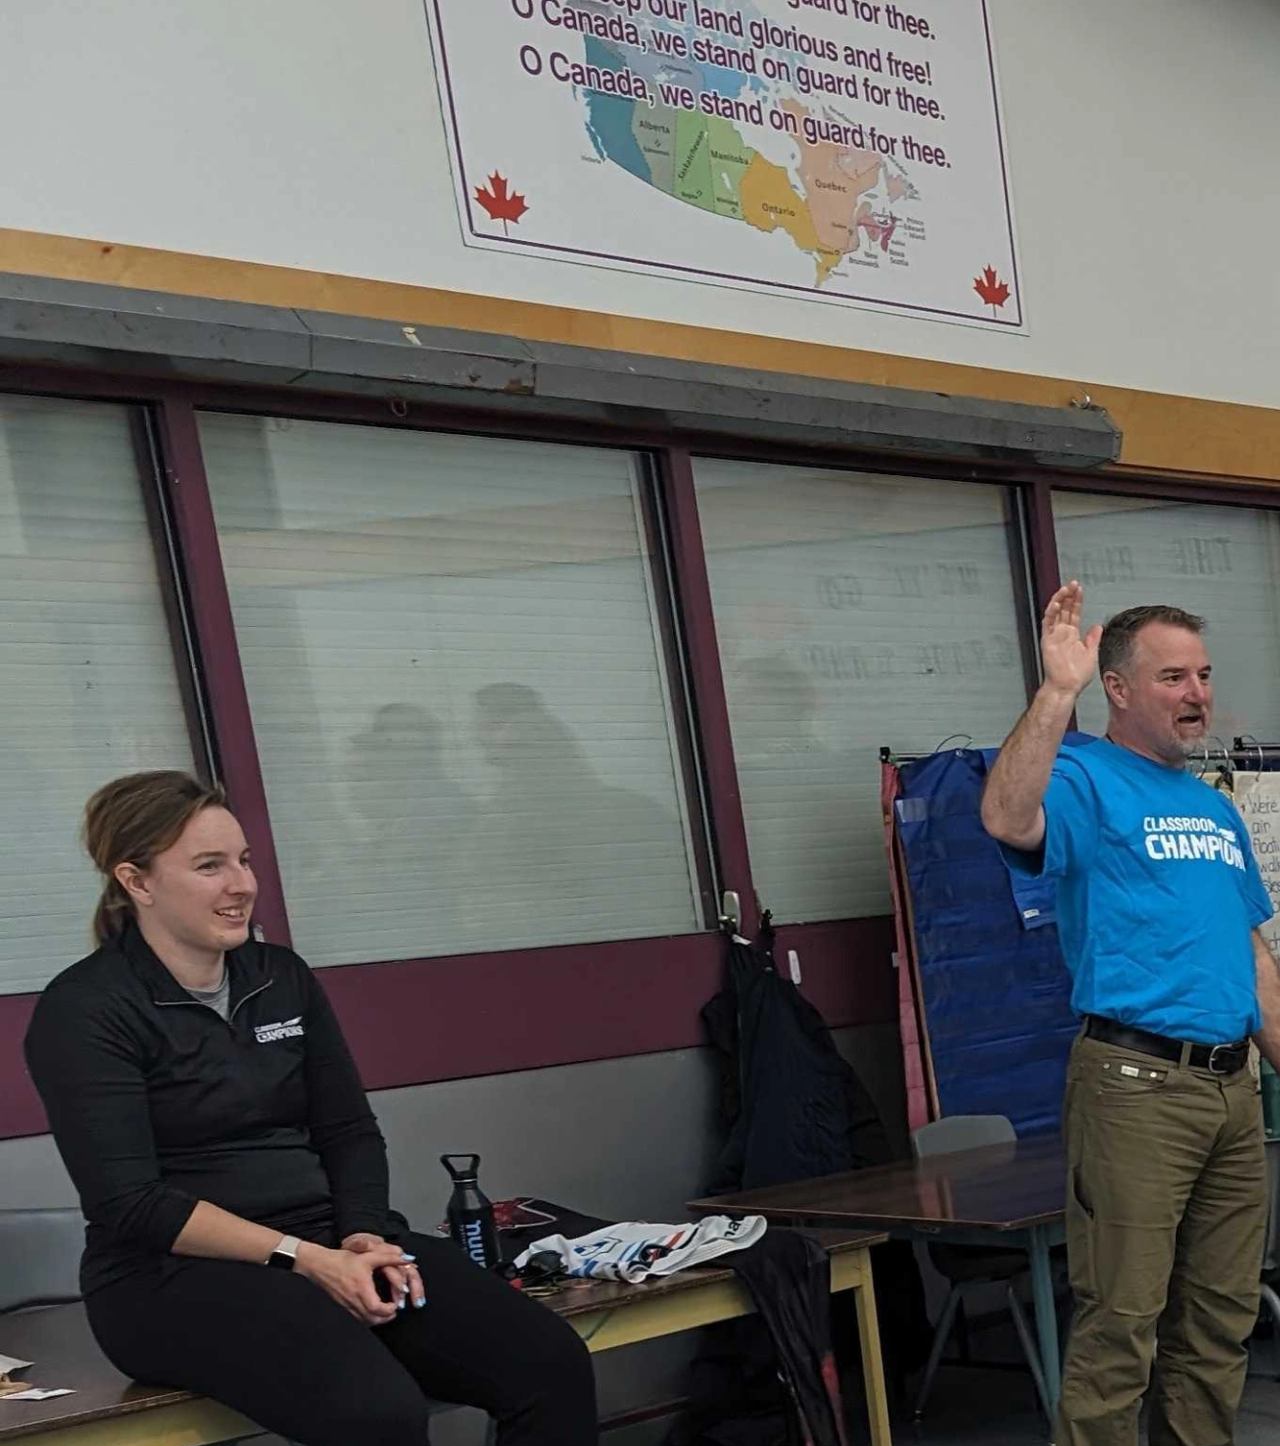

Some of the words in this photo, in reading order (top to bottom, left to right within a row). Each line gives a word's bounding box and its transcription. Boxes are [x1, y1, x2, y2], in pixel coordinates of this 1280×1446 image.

[852, 0, 881, 24] for
[884, 4, 936, 40] thee.
[511, 0, 534, 19] O
[541, 0, 647, 52] Canada,
[650, 29, 687, 57] we
[692, 37, 757, 75] stand
[762, 56, 792, 83] on
[796, 66, 859, 100] guard
[862, 77, 892, 107] for
[894, 86, 946, 120] thee.
[648, 0, 687, 22] our
[692, 0, 744, 37] land
[749, 17, 839, 62] glorious
[843, 45, 883, 73] and
[886, 50, 933, 86] free!
[519, 44, 543, 76] O
[549, 50, 655, 107] Canada,
[658, 81, 695, 111] we
[700, 90, 764, 126] stand
[768, 108, 799, 135] on
[802, 116, 866, 149] guard
[868, 127, 899, 154] for
[900, 135, 953, 169] thee.
[710, 150, 750, 167] Manitoba
[814, 177, 849, 194] Quebec
[760, 201, 797, 218] Ontario
[1143, 816, 1218, 833] CLASSROOM
[1144, 834, 1247, 873] CHAMPION
